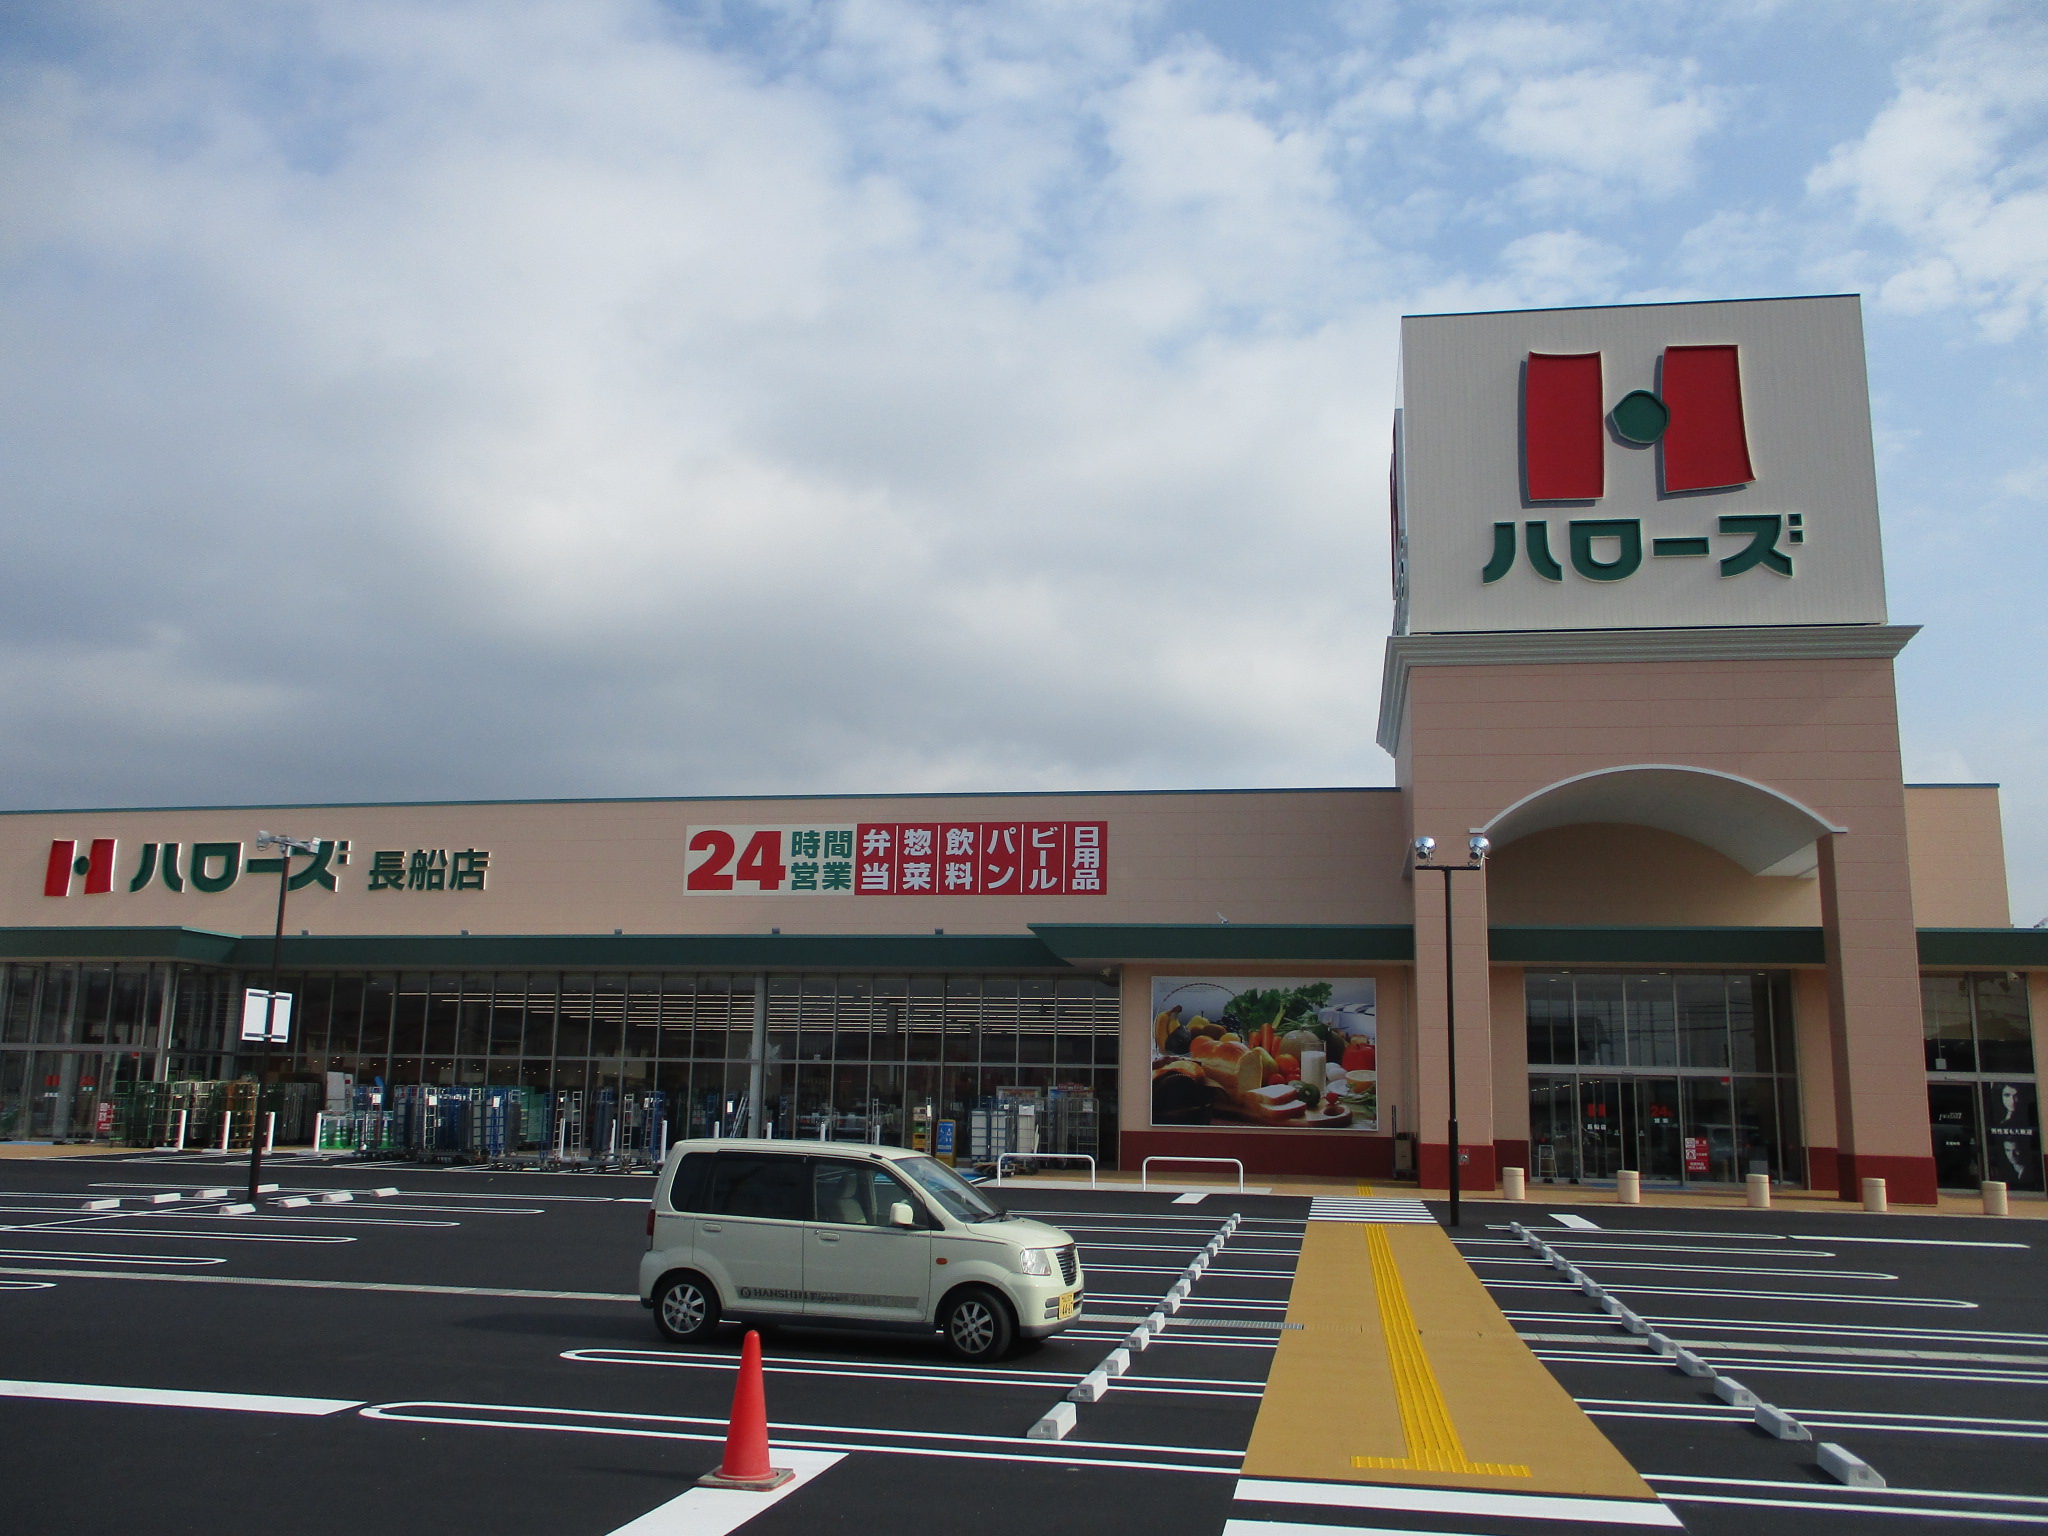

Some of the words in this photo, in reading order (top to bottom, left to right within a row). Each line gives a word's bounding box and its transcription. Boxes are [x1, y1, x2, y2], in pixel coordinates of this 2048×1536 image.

[1483, 513, 1804, 586] ハローズ
[129, 840, 352, 894] ハローズ
[367, 847, 492, 891] 長船店
[687, 829, 788, 891] 24
[791, 829, 854, 860] 時間
[790, 861, 853, 891] 営業
[860, 828, 892, 890] 弁当
[902, 828, 932, 890] 惣菜
[945, 827, 975, 890] 飲料
[986, 826, 1018, 889] パン
[1028, 826, 1060, 890] ビール
[1071, 826, 1101, 890] 日用品
